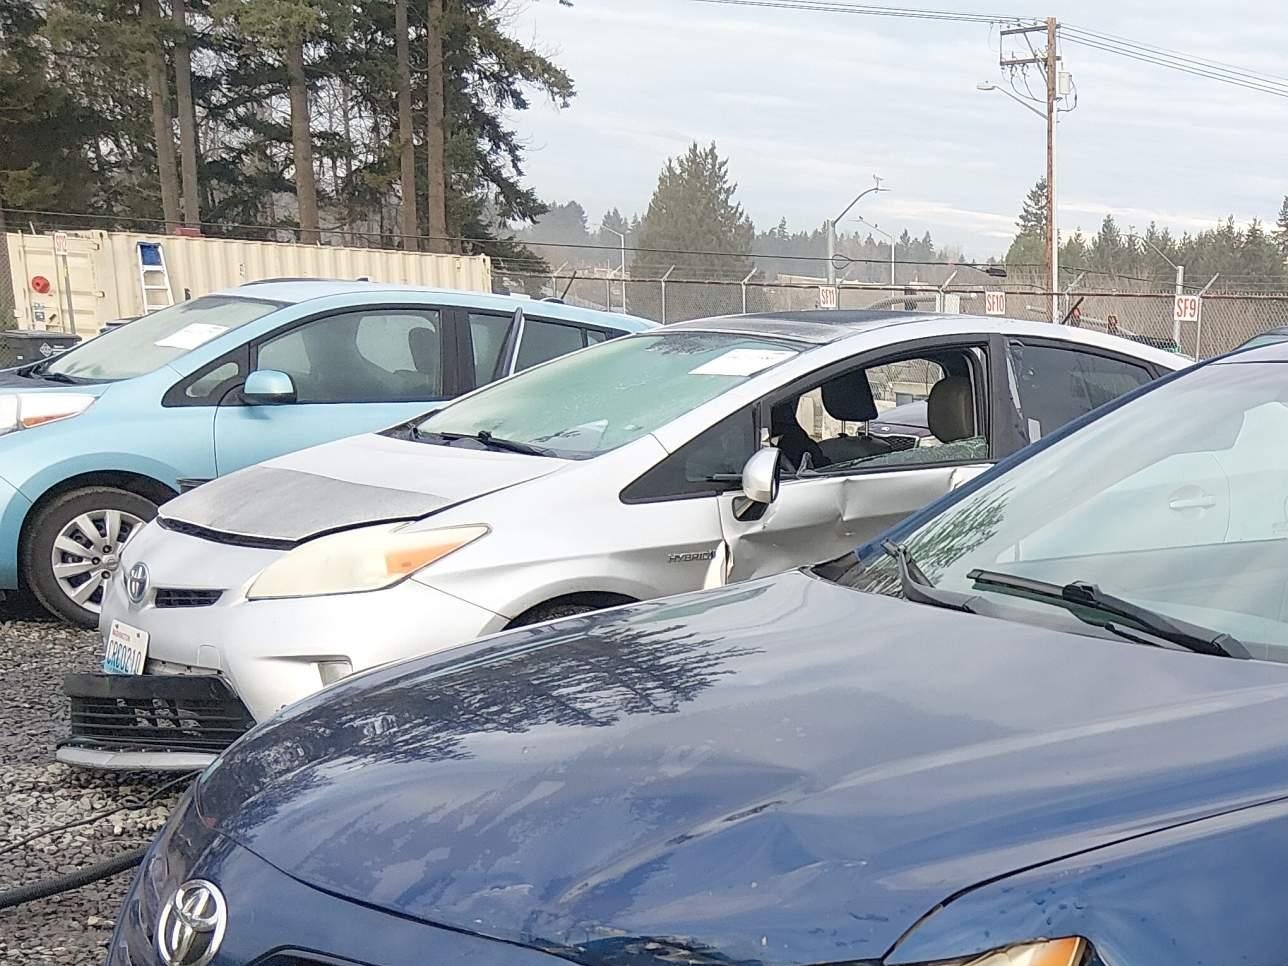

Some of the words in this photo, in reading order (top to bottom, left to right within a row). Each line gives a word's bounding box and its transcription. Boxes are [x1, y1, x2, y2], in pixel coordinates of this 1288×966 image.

[821, 288, 835, 305] SF11
[986, 294, 1004, 312] SF10
[1176, 297, 1196, 317] SF9
